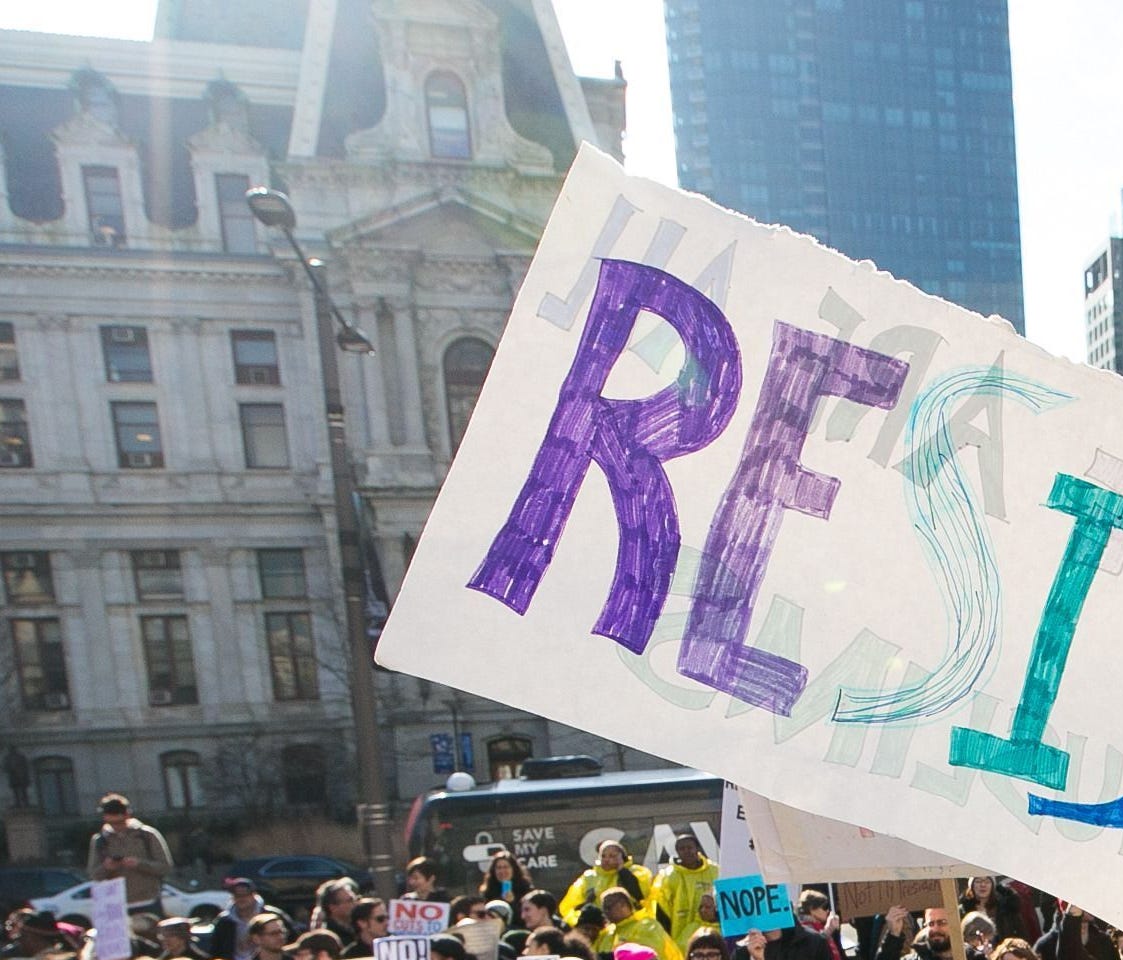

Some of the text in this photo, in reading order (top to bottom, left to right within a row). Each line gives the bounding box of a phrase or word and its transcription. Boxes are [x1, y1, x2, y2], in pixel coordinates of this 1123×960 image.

[513, 827, 555, 840] SAVE
[515, 842, 538, 855] MY
[519, 855, 558, 869] CARE
[720, 883, 790, 921] NOPE.
[395, 903, 443, 920] NO
[393, 922, 441, 933] CUTS TO
